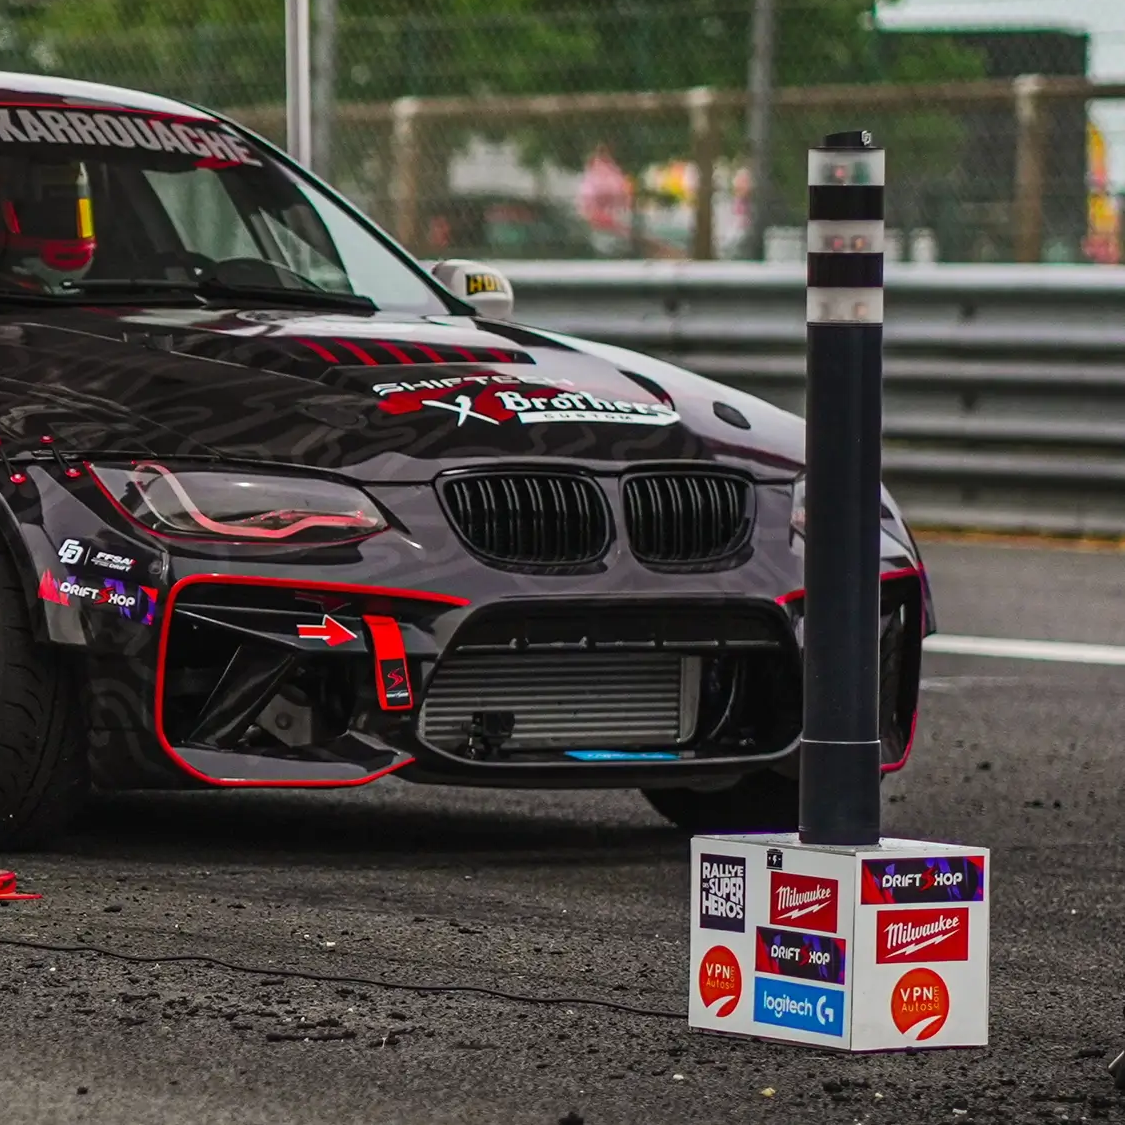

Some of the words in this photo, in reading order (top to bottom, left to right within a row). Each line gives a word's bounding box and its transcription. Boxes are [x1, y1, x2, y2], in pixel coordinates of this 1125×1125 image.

[373, 375, 575, 396] SHIFTECH
[543, 412, 634, 422] CUSTOM
[96, 551, 134, 564] FFSA
[702, 862, 744, 879] RALLYE
[709, 877, 744, 906] SUPER
[775, 884, 831, 911] Milwaukee
[702, 891, 744, 920] HEROS
[884, 915, 960, 950] Milwaukee
[705, 962, 730, 979] VPN
[706, 978, 730, 990] Autos
[900, 986, 933, 1002] VPN
[763, 990, 812, 1018] logitech
[901, 1000, 933, 1012] Autos
